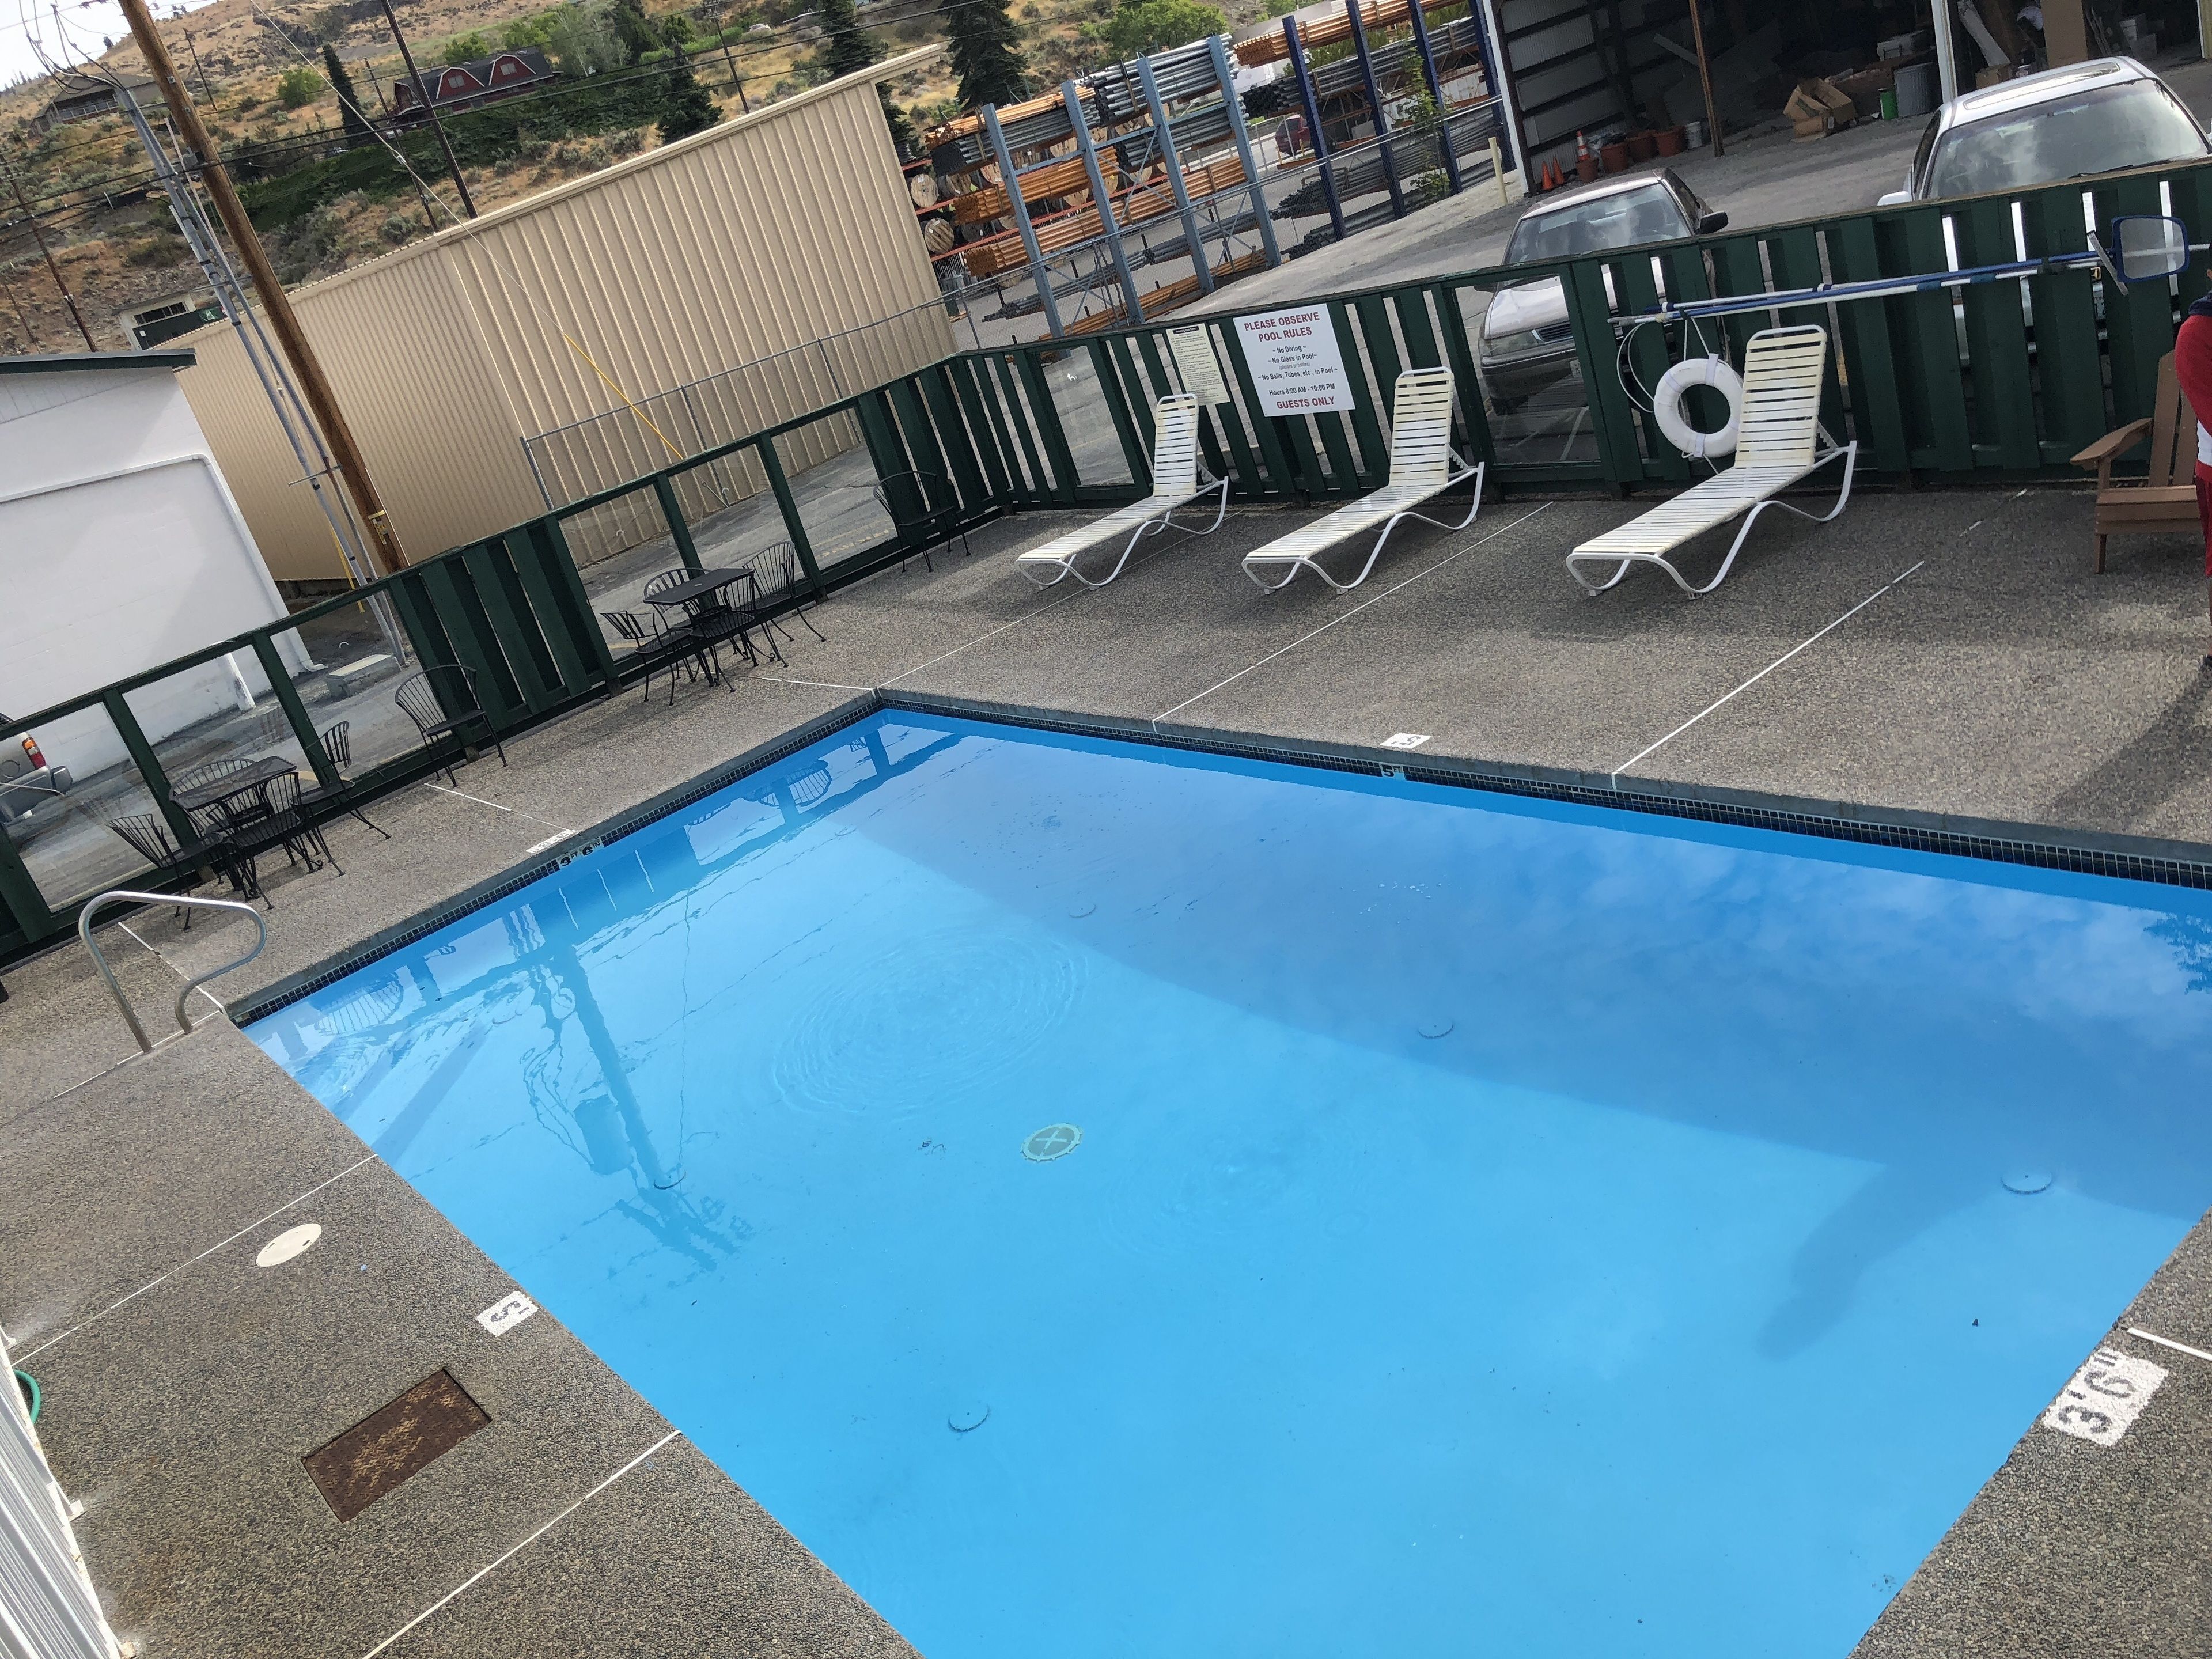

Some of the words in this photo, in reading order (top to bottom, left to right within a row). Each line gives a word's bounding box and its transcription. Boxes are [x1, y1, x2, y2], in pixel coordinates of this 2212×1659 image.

[1244, 319, 1277, 331] PLEASE
[1278, 312, 1320, 326] OBSERVE
[1258, 331, 1282, 342] POOL
[1283, 327, 1312, 339] RULES
[1320, 366, 1334, 374] Pool
[1277, 399, 1310, 409] GUESTS
[1312, 396, 1334, 406] ONLY
[1382, 764, 1394, 777] 5
[560, 857, 572, 867] 3
[582, 846, 594, 856] 6
